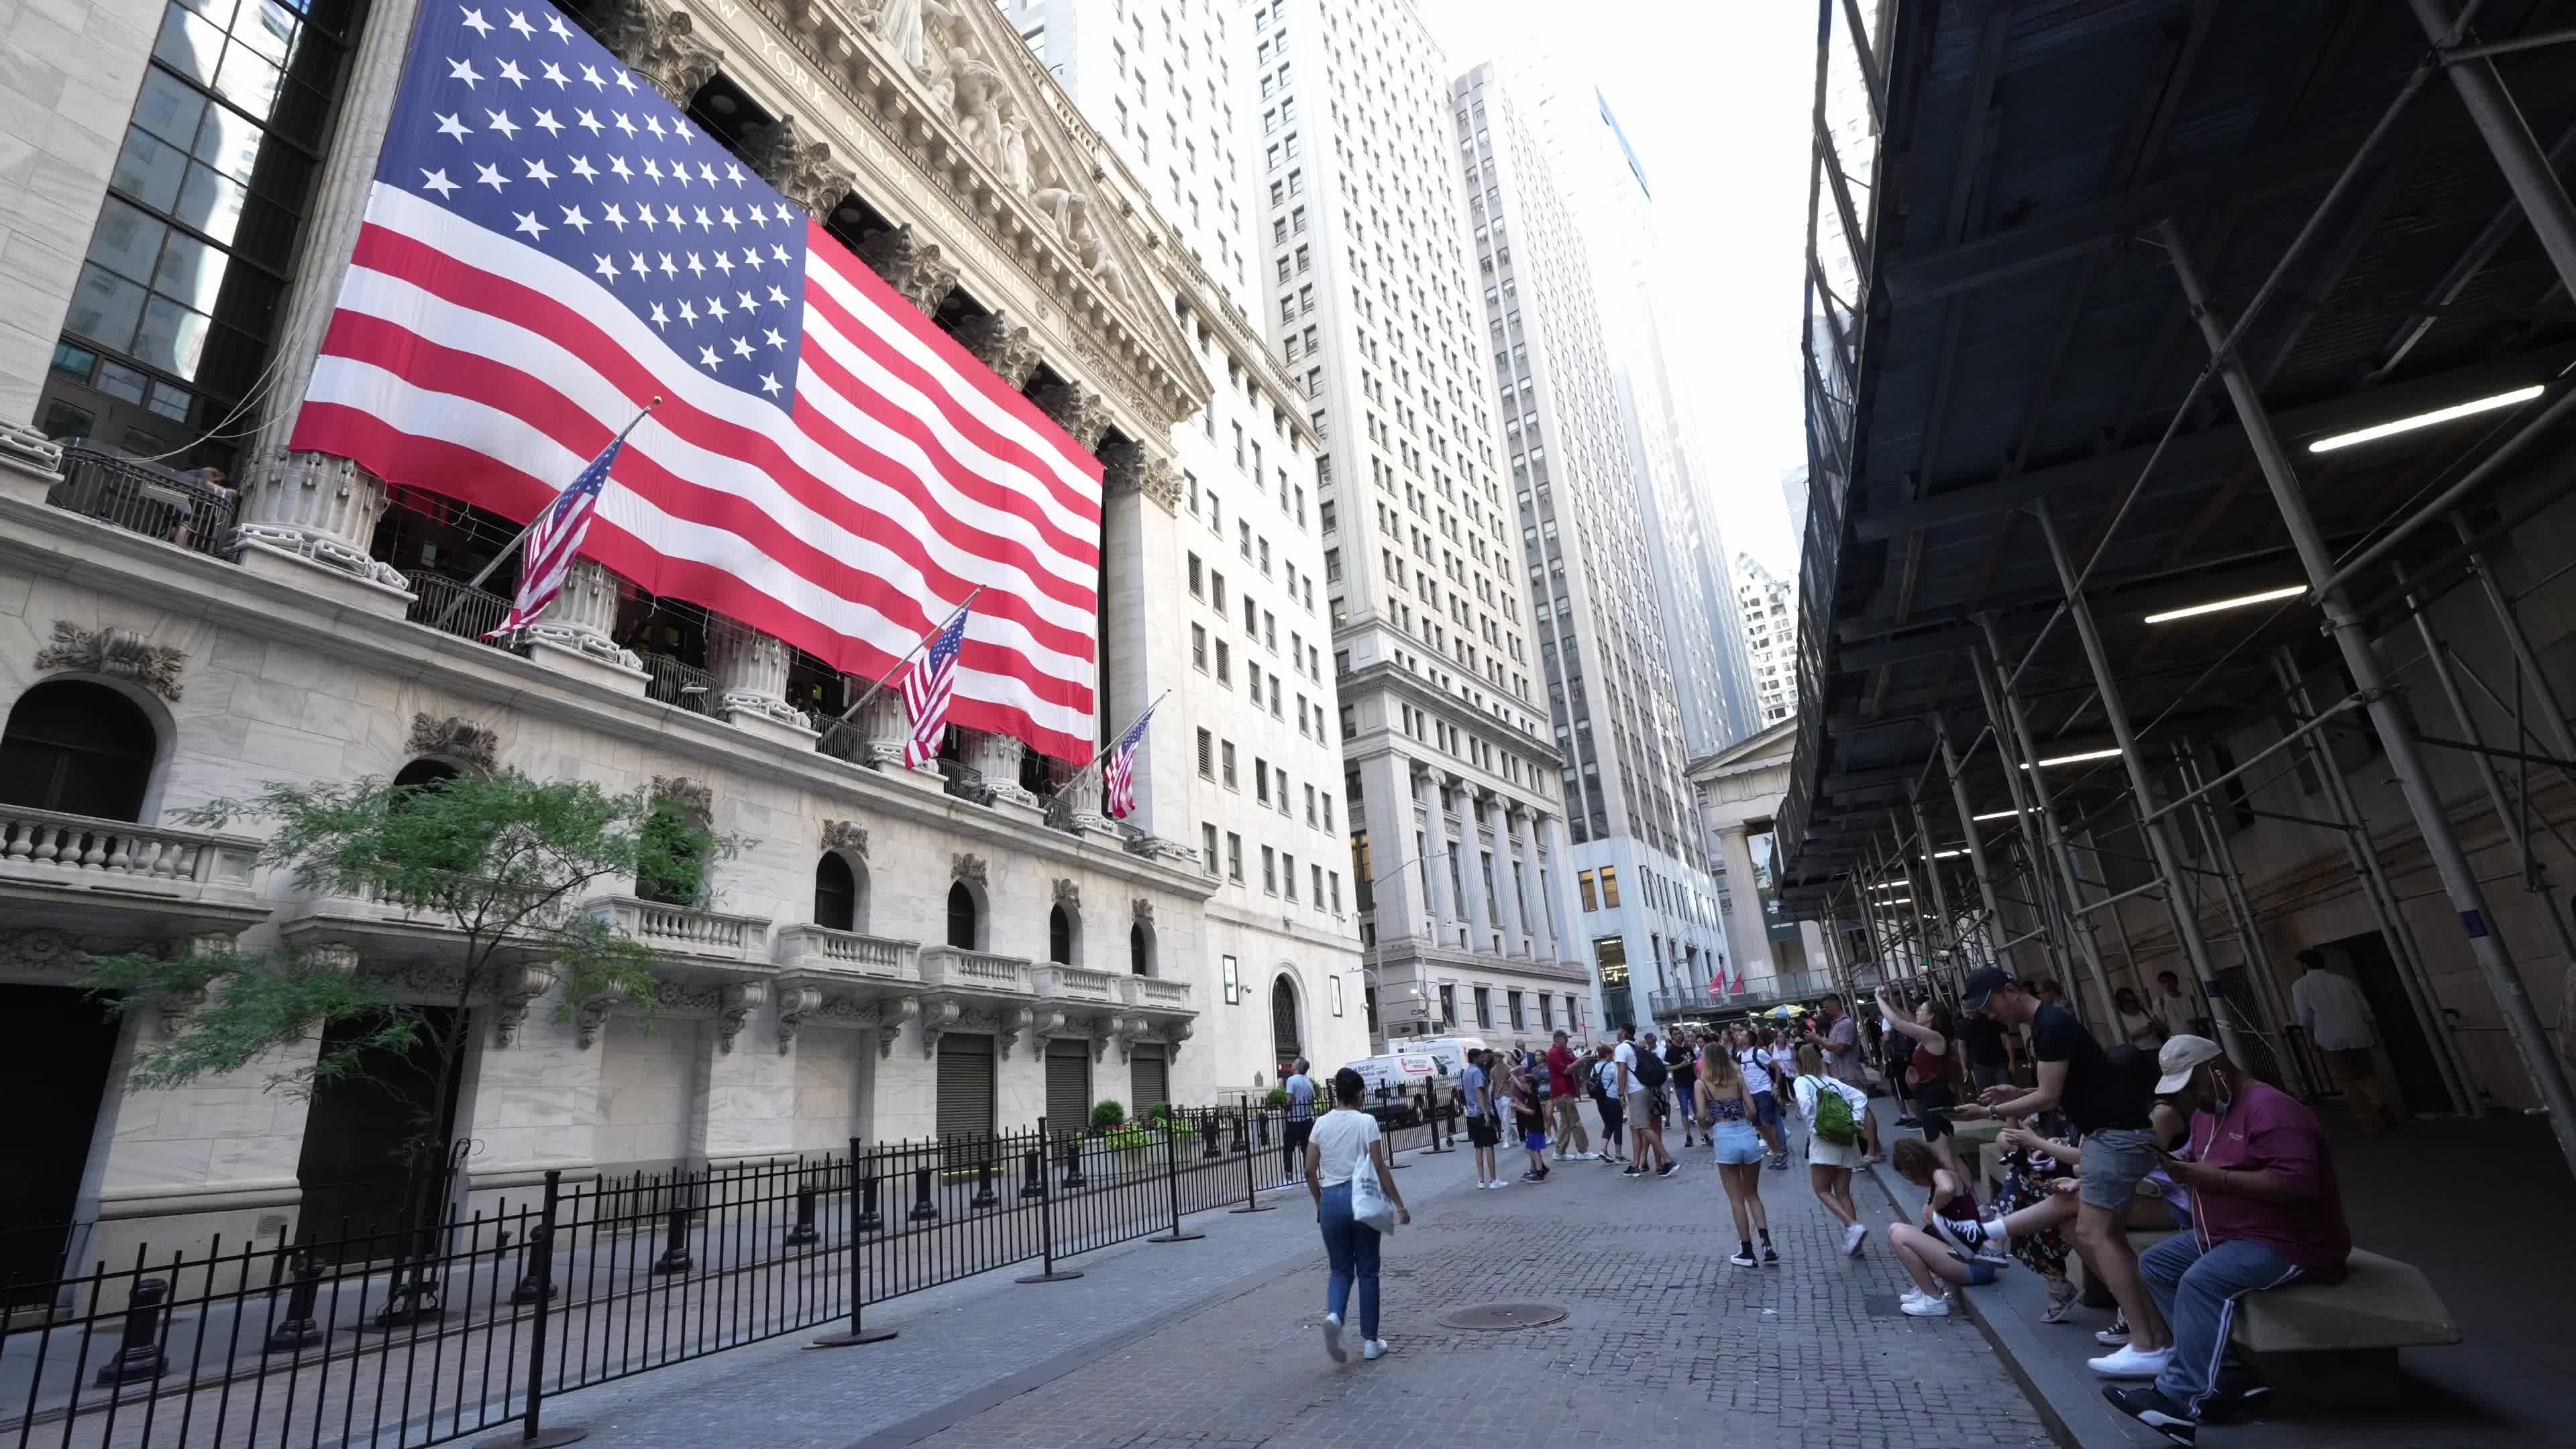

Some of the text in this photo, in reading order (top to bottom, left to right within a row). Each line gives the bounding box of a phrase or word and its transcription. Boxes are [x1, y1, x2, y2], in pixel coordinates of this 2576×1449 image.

[757, 27, 828, 112] YORK
[843, 115, 914, 194] STOCK
[924, 192, 1024, 293] EXCHANGE
